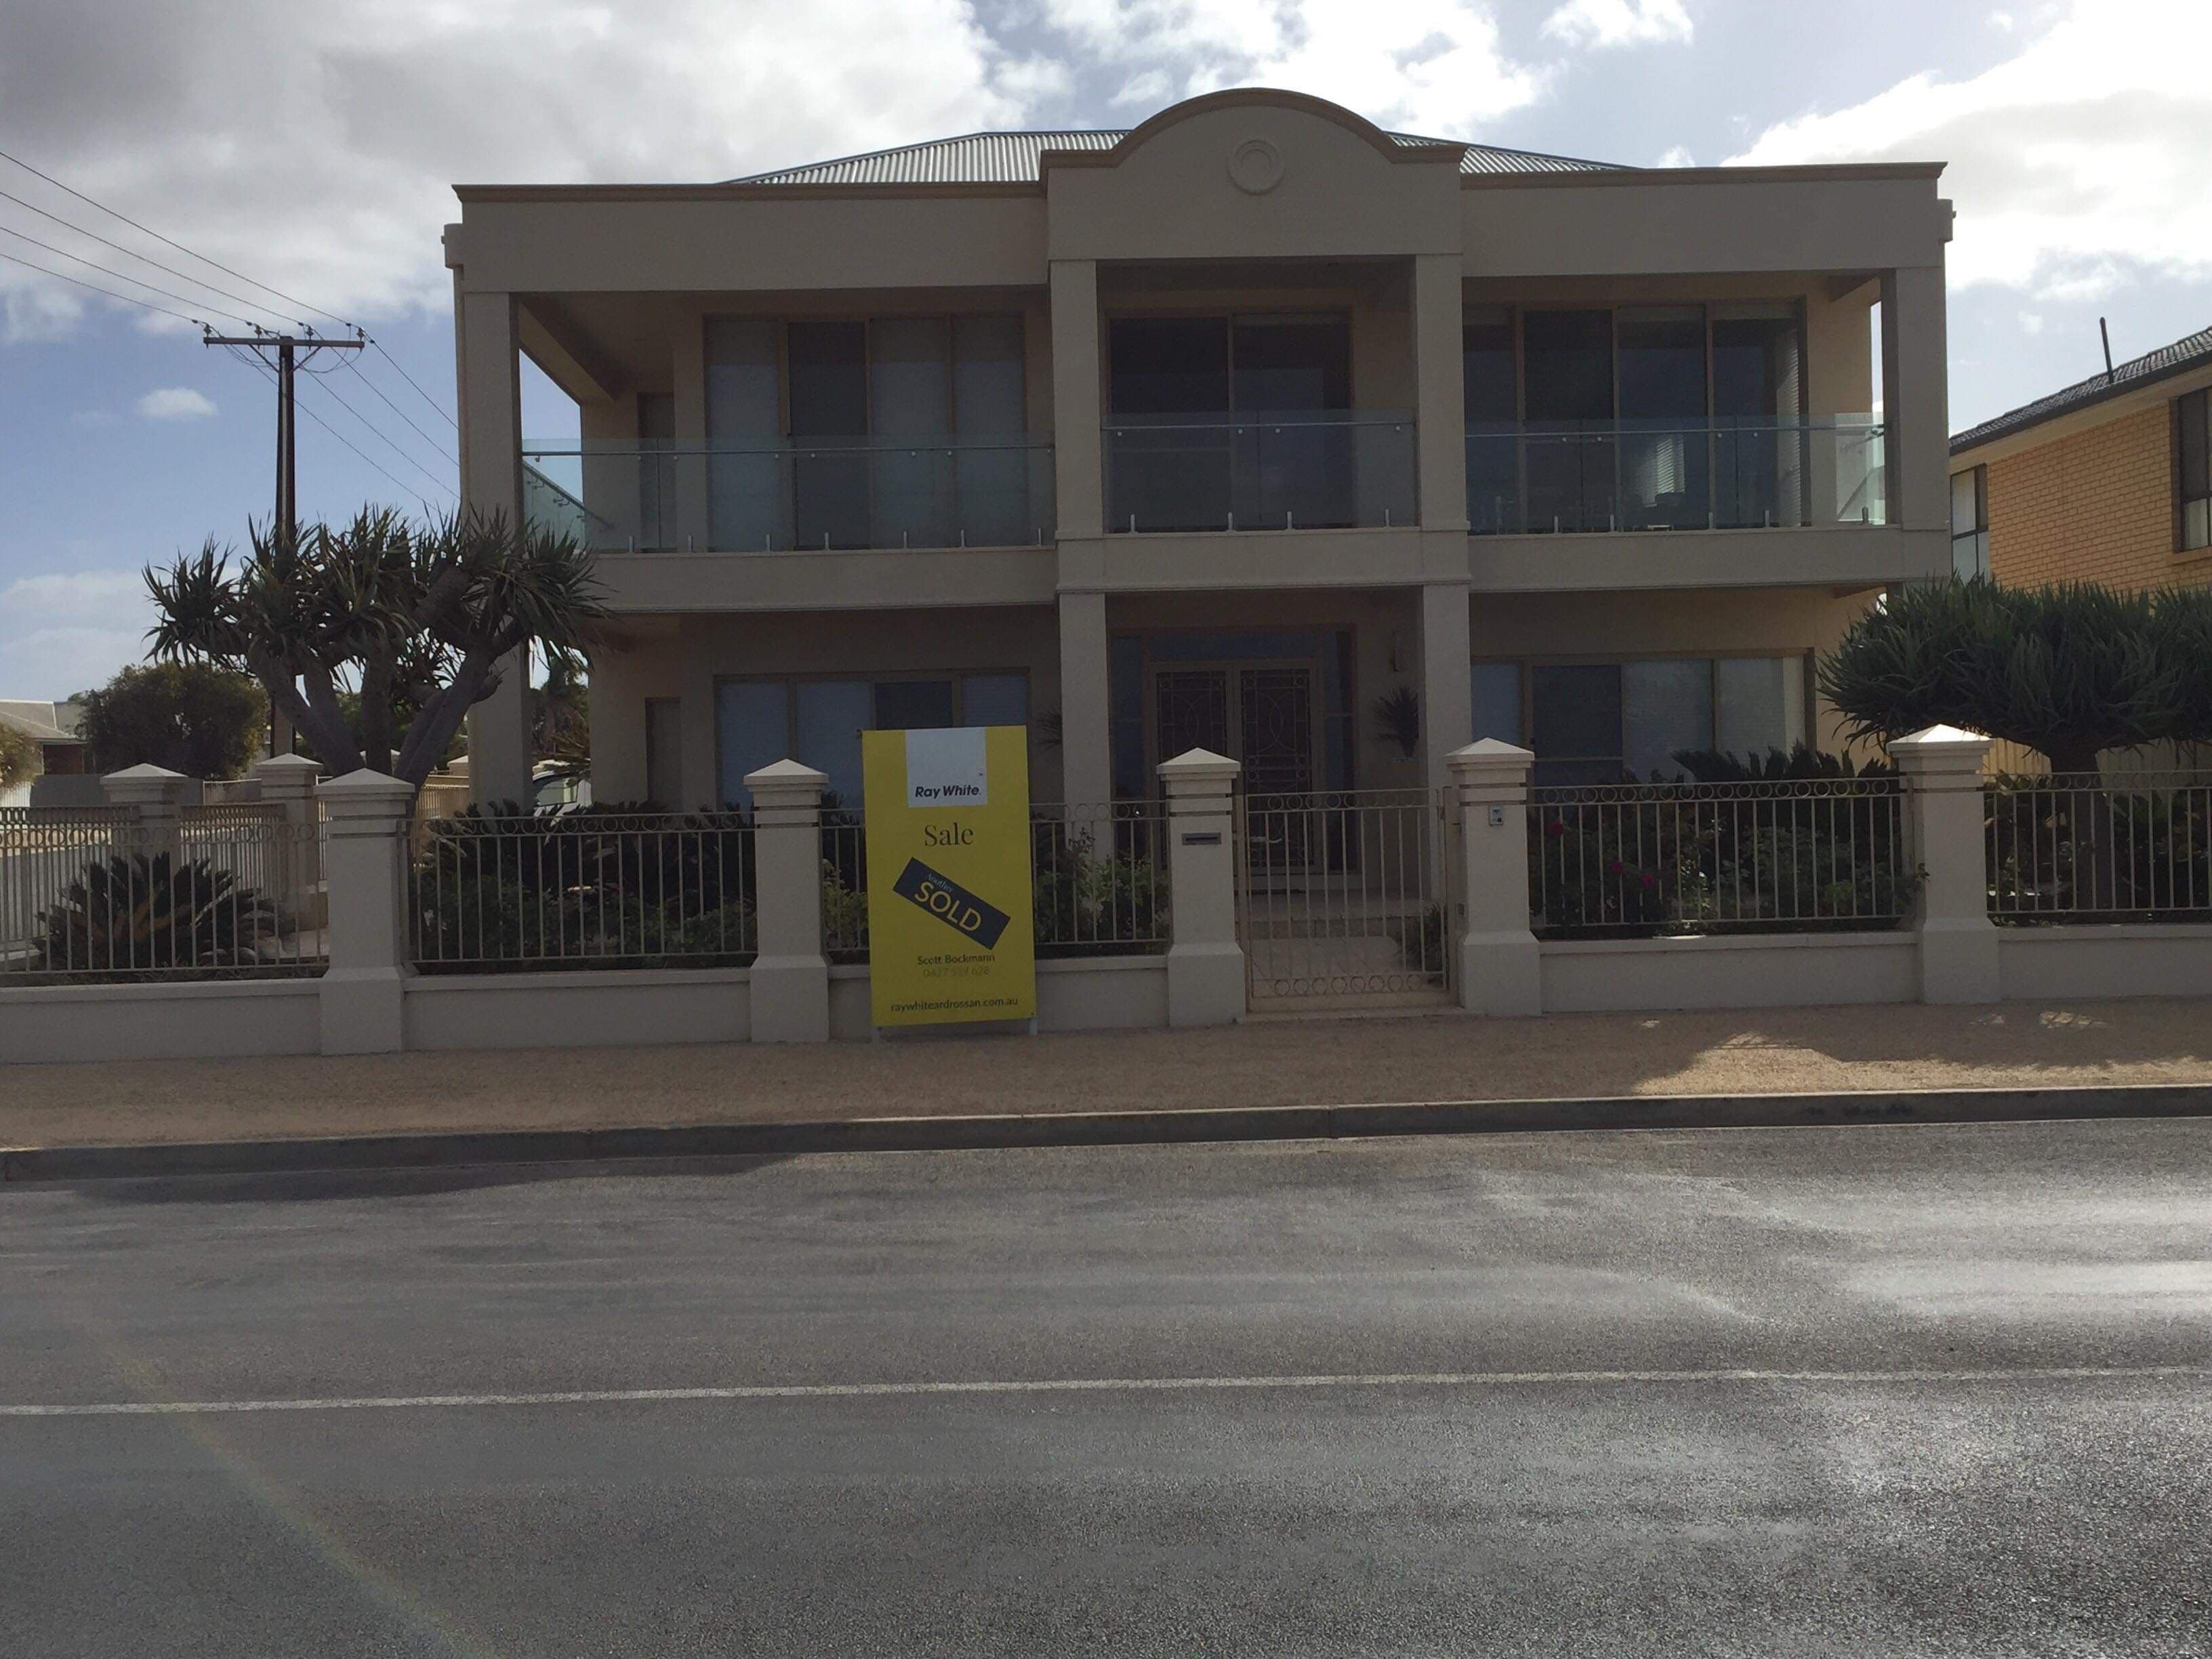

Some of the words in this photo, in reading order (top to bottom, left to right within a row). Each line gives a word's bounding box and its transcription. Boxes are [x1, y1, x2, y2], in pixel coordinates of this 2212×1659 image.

[915, 785, 941, 799] Ray
[924, 822, 975, 846] Sale
[926, 874, 955, 893] Another
[914, 882, 981, 932] SOLD
[917, 956, 942, 966] Scott
[945, 954, 996, 964] Bockmann
[890, 998, 1018, 1012] raywhiteardrossan.com.au
